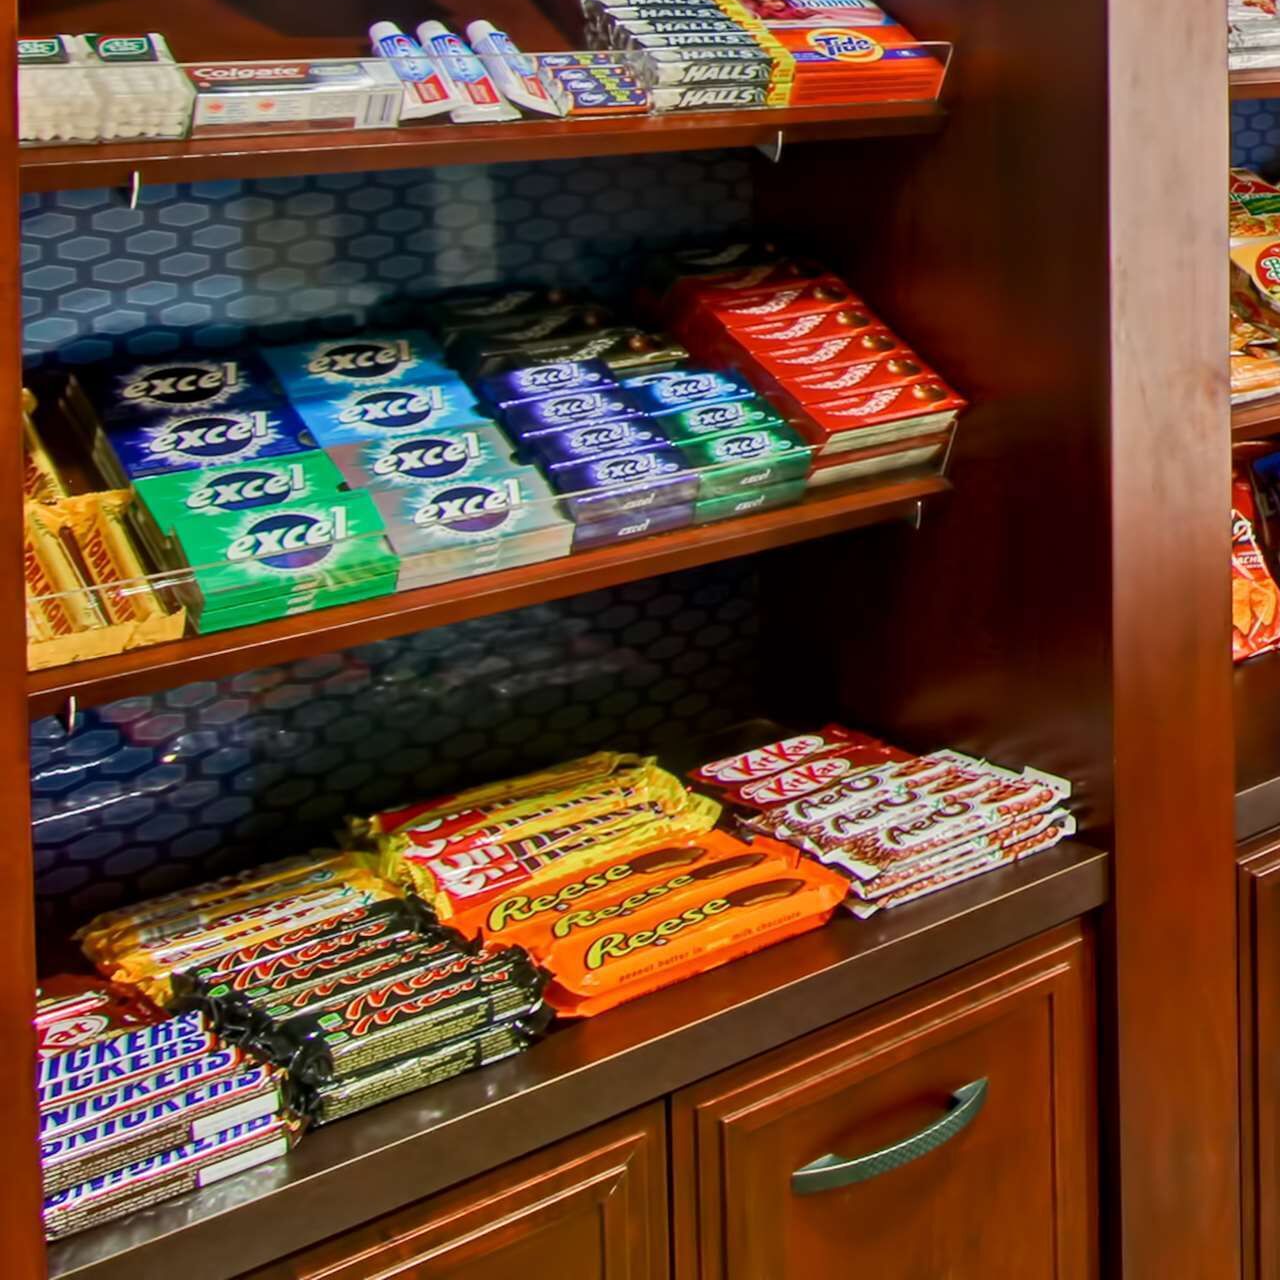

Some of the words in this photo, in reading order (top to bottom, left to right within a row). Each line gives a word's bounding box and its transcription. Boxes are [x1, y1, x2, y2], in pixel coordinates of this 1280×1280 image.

[638, 8, 712, 18] HALLS
[654, 22, 728, 33] HALLS
[813, 33, 874, 59] Tide
[194, 65, 301, 80] Colgate
[681, 63, 760, 83] HALLS
[678, 86, 757, 108] HALLS
[307, 339, 412, 373] excel
[122, 361, 238, 399] excel
[339, 386, 445, 423] excel
[149, 411, 268, 453] excel
[570, 423, 630, 449] excel
[374, 433, 480, 475] excel
[596, 453, 657, 482] excel
[186, 464, 305, 509] excel
[414, 478, 521, 526] excel
[227, 506, 348, 562] excel
[488, 862, 634, 933] Reese
[552, 873, 695, 938] Reese
[216, 907, 369, 972] Mars
[585, 895, 731, 971] Reese
[234, 922, 386, 991] Mars
[345, 949, 499, 1020] Mars
[39, 1010, 203, 1087] ICKERS
